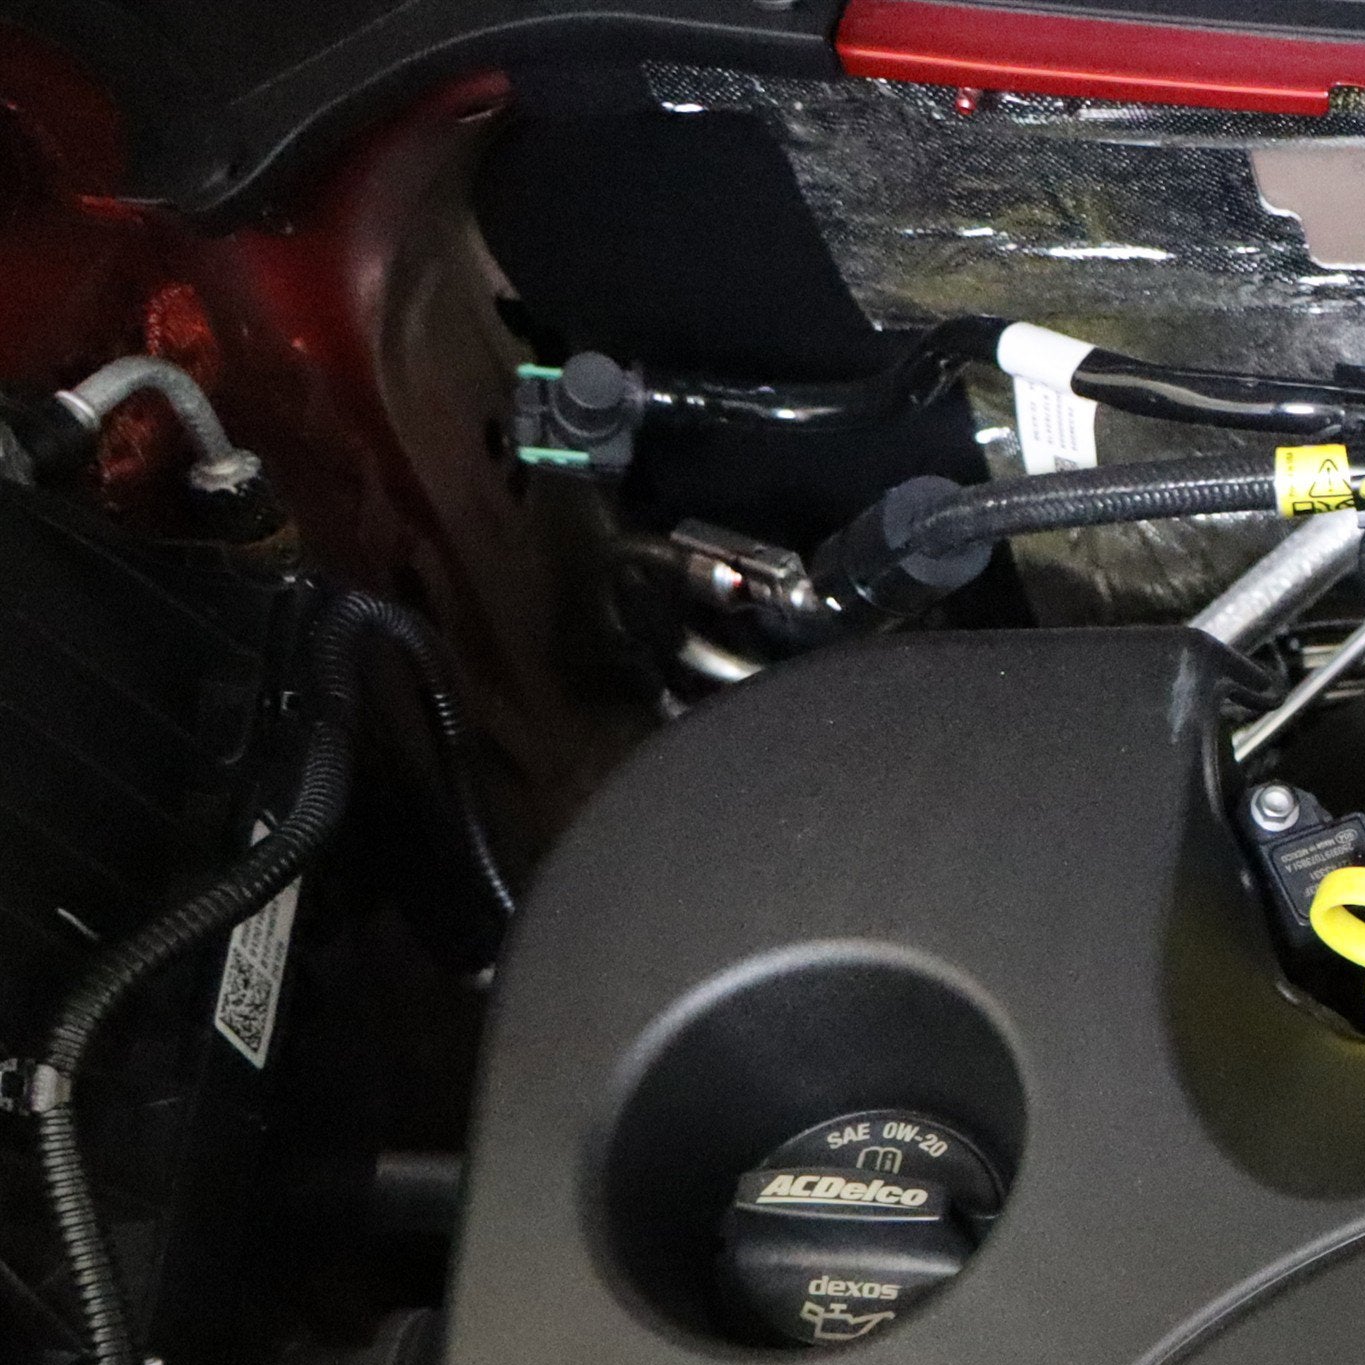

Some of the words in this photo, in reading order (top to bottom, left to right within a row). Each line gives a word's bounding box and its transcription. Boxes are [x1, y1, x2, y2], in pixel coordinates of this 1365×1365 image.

[826, 1122, 871, 1150] SAE
[882, 1121, 948, 1158] 0W-20
[760, 1174, 928, 1206] ACDelco
[808, 1275, 902, 1301] dexos
